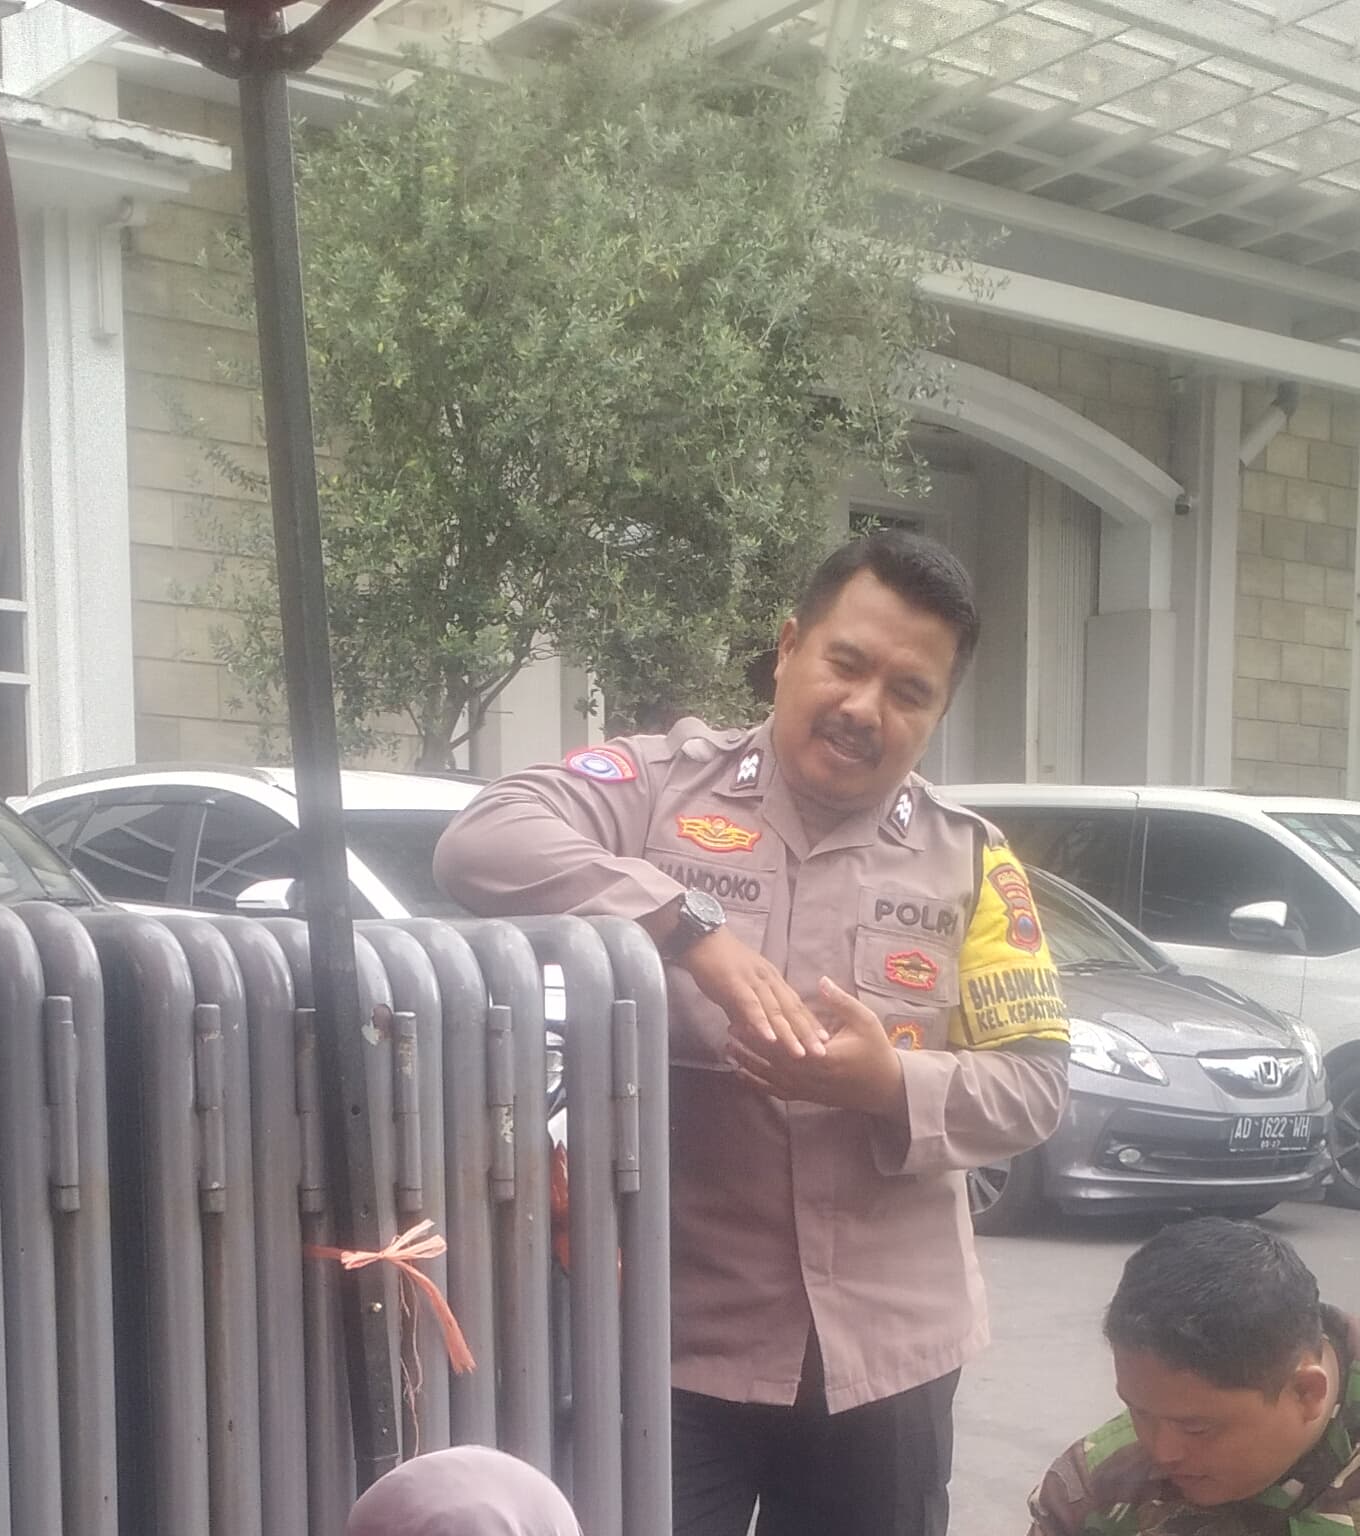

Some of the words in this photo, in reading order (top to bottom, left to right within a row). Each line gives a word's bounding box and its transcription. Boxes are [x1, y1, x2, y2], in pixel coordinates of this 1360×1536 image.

[874, 898, 959, 936] POLRI
[1234, 1117, 1252, 1139] AD
[1260, 1116, 1288, 1138] 1622
[1292, 1116, 1310, 1137] WH
